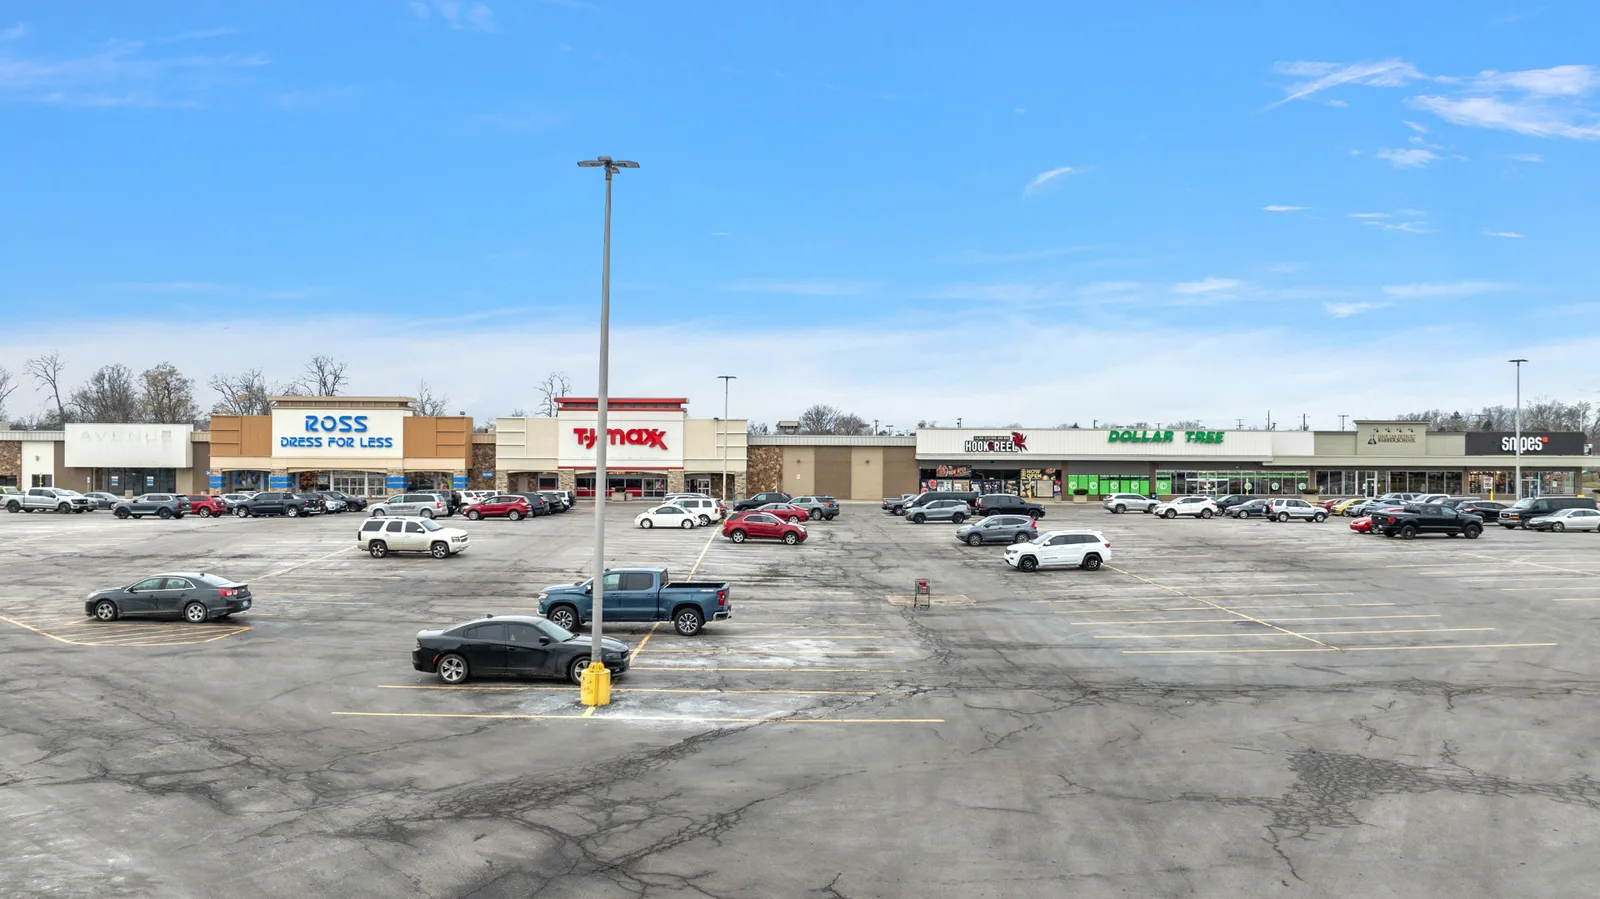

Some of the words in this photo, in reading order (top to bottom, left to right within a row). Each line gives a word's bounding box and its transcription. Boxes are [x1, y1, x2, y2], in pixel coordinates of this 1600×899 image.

[305, 415, 368, 432] ROSS
[280, 437, 323, 448] DRESS
[328, 437, 354, 448] FOR
[360, 437, 393, 448] LESS
[1108, 430, 1174, 443] DOLLAR
[1185, 431, 1225, 443] TREE
[965, 441, 989, 451] HOOK
[994, 441, 1018, 451] REEL
[1502, 436, 1542, 454] snpes
